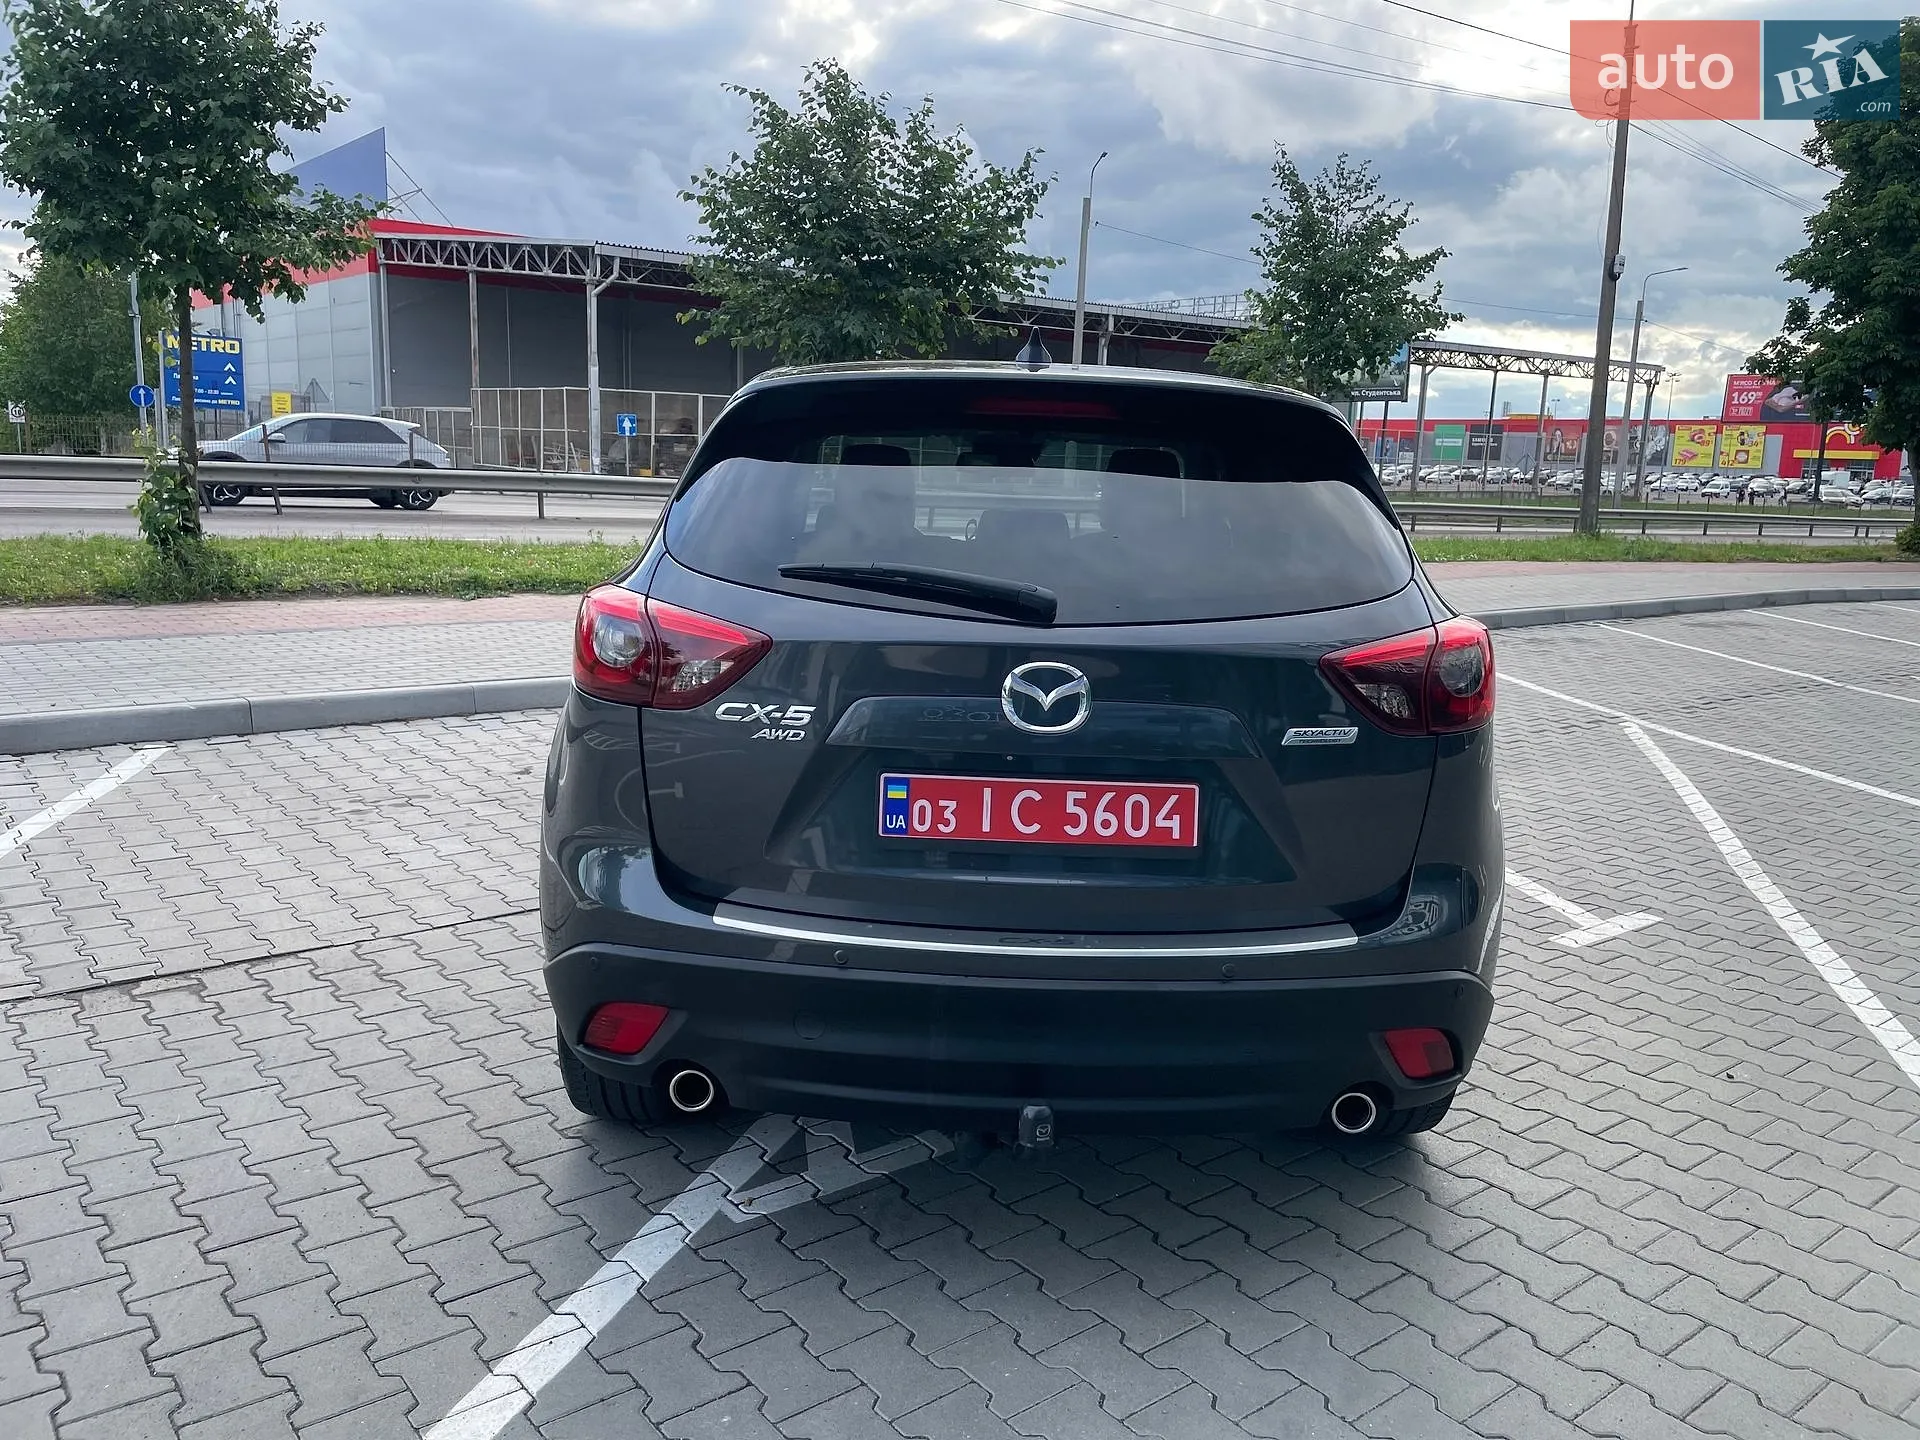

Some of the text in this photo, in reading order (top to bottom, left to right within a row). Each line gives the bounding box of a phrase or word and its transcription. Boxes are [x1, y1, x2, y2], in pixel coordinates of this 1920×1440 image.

[1361, 389, 1401, 397] Студентська
[1731, 391, 1756, 404] 169
[715, 702, 817, 726] CX-5
[751, 728, 806, 741] AWD
[1292, 729, 1352, 737] SKYACTIV
[885, 814, 906, 829] UA
[912, 799, 957, 833] 03
[1063, 790, 1180, 840] 5604
